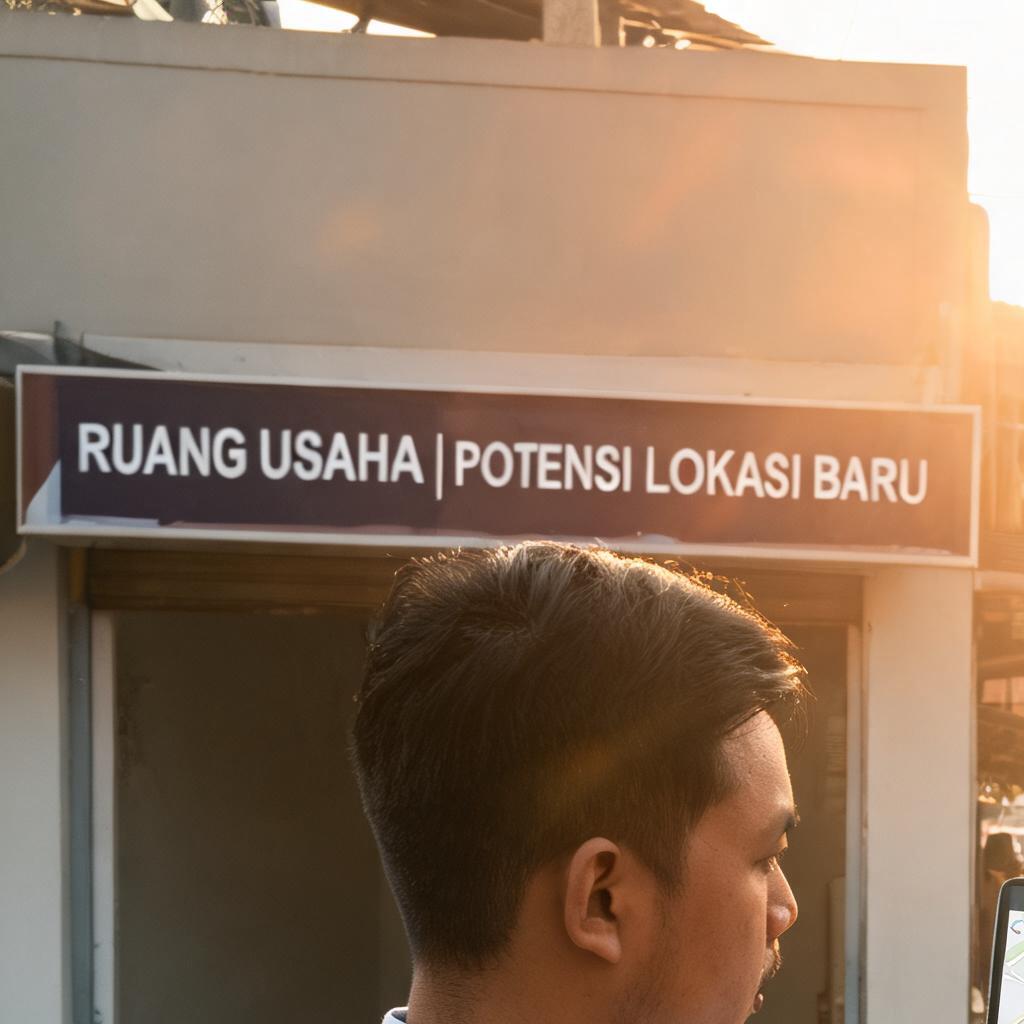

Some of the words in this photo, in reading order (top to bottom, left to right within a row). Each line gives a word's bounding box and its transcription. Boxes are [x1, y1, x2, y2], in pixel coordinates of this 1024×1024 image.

[77, 422, 248, 480] RUANG
[260, 428, 424, 484] USAHA
[455, 440, 631, 492] POTENSI
[645, 447, 800, 500] LOKASI
[813, 454, 928, 505] BARU
